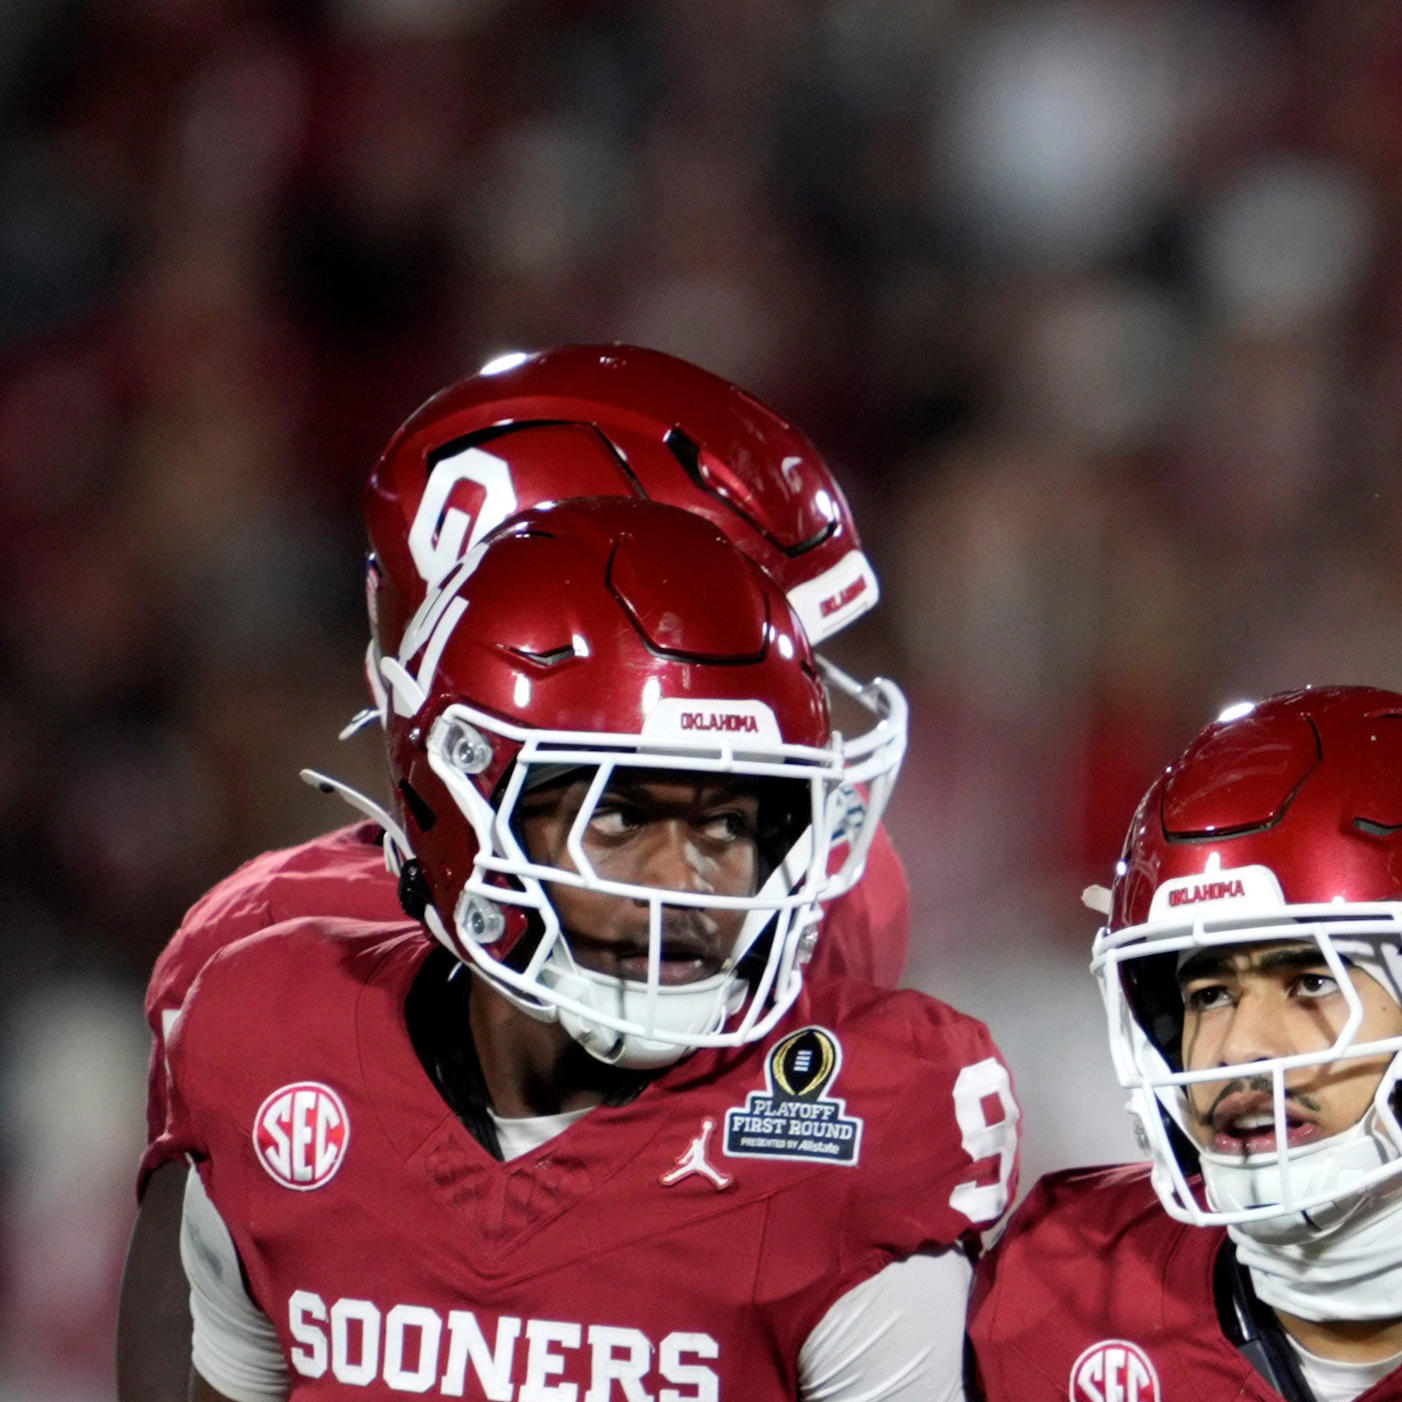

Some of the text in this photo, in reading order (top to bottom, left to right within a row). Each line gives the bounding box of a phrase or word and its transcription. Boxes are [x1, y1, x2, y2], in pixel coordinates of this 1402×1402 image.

[681, 712, 759, 733] OKLAHOMA
[1168, 879, 1246, 908] OKLAHOMA
[752, 1099, 836, 1121] PLAYOFF
[261, 1086, 342, 1187] SEC
[732, 1116, 853, 1140] FIRST ROUND
[948, 1056, 1021, 1223] 9
[798, 1139, 840, 1154] Allstate
